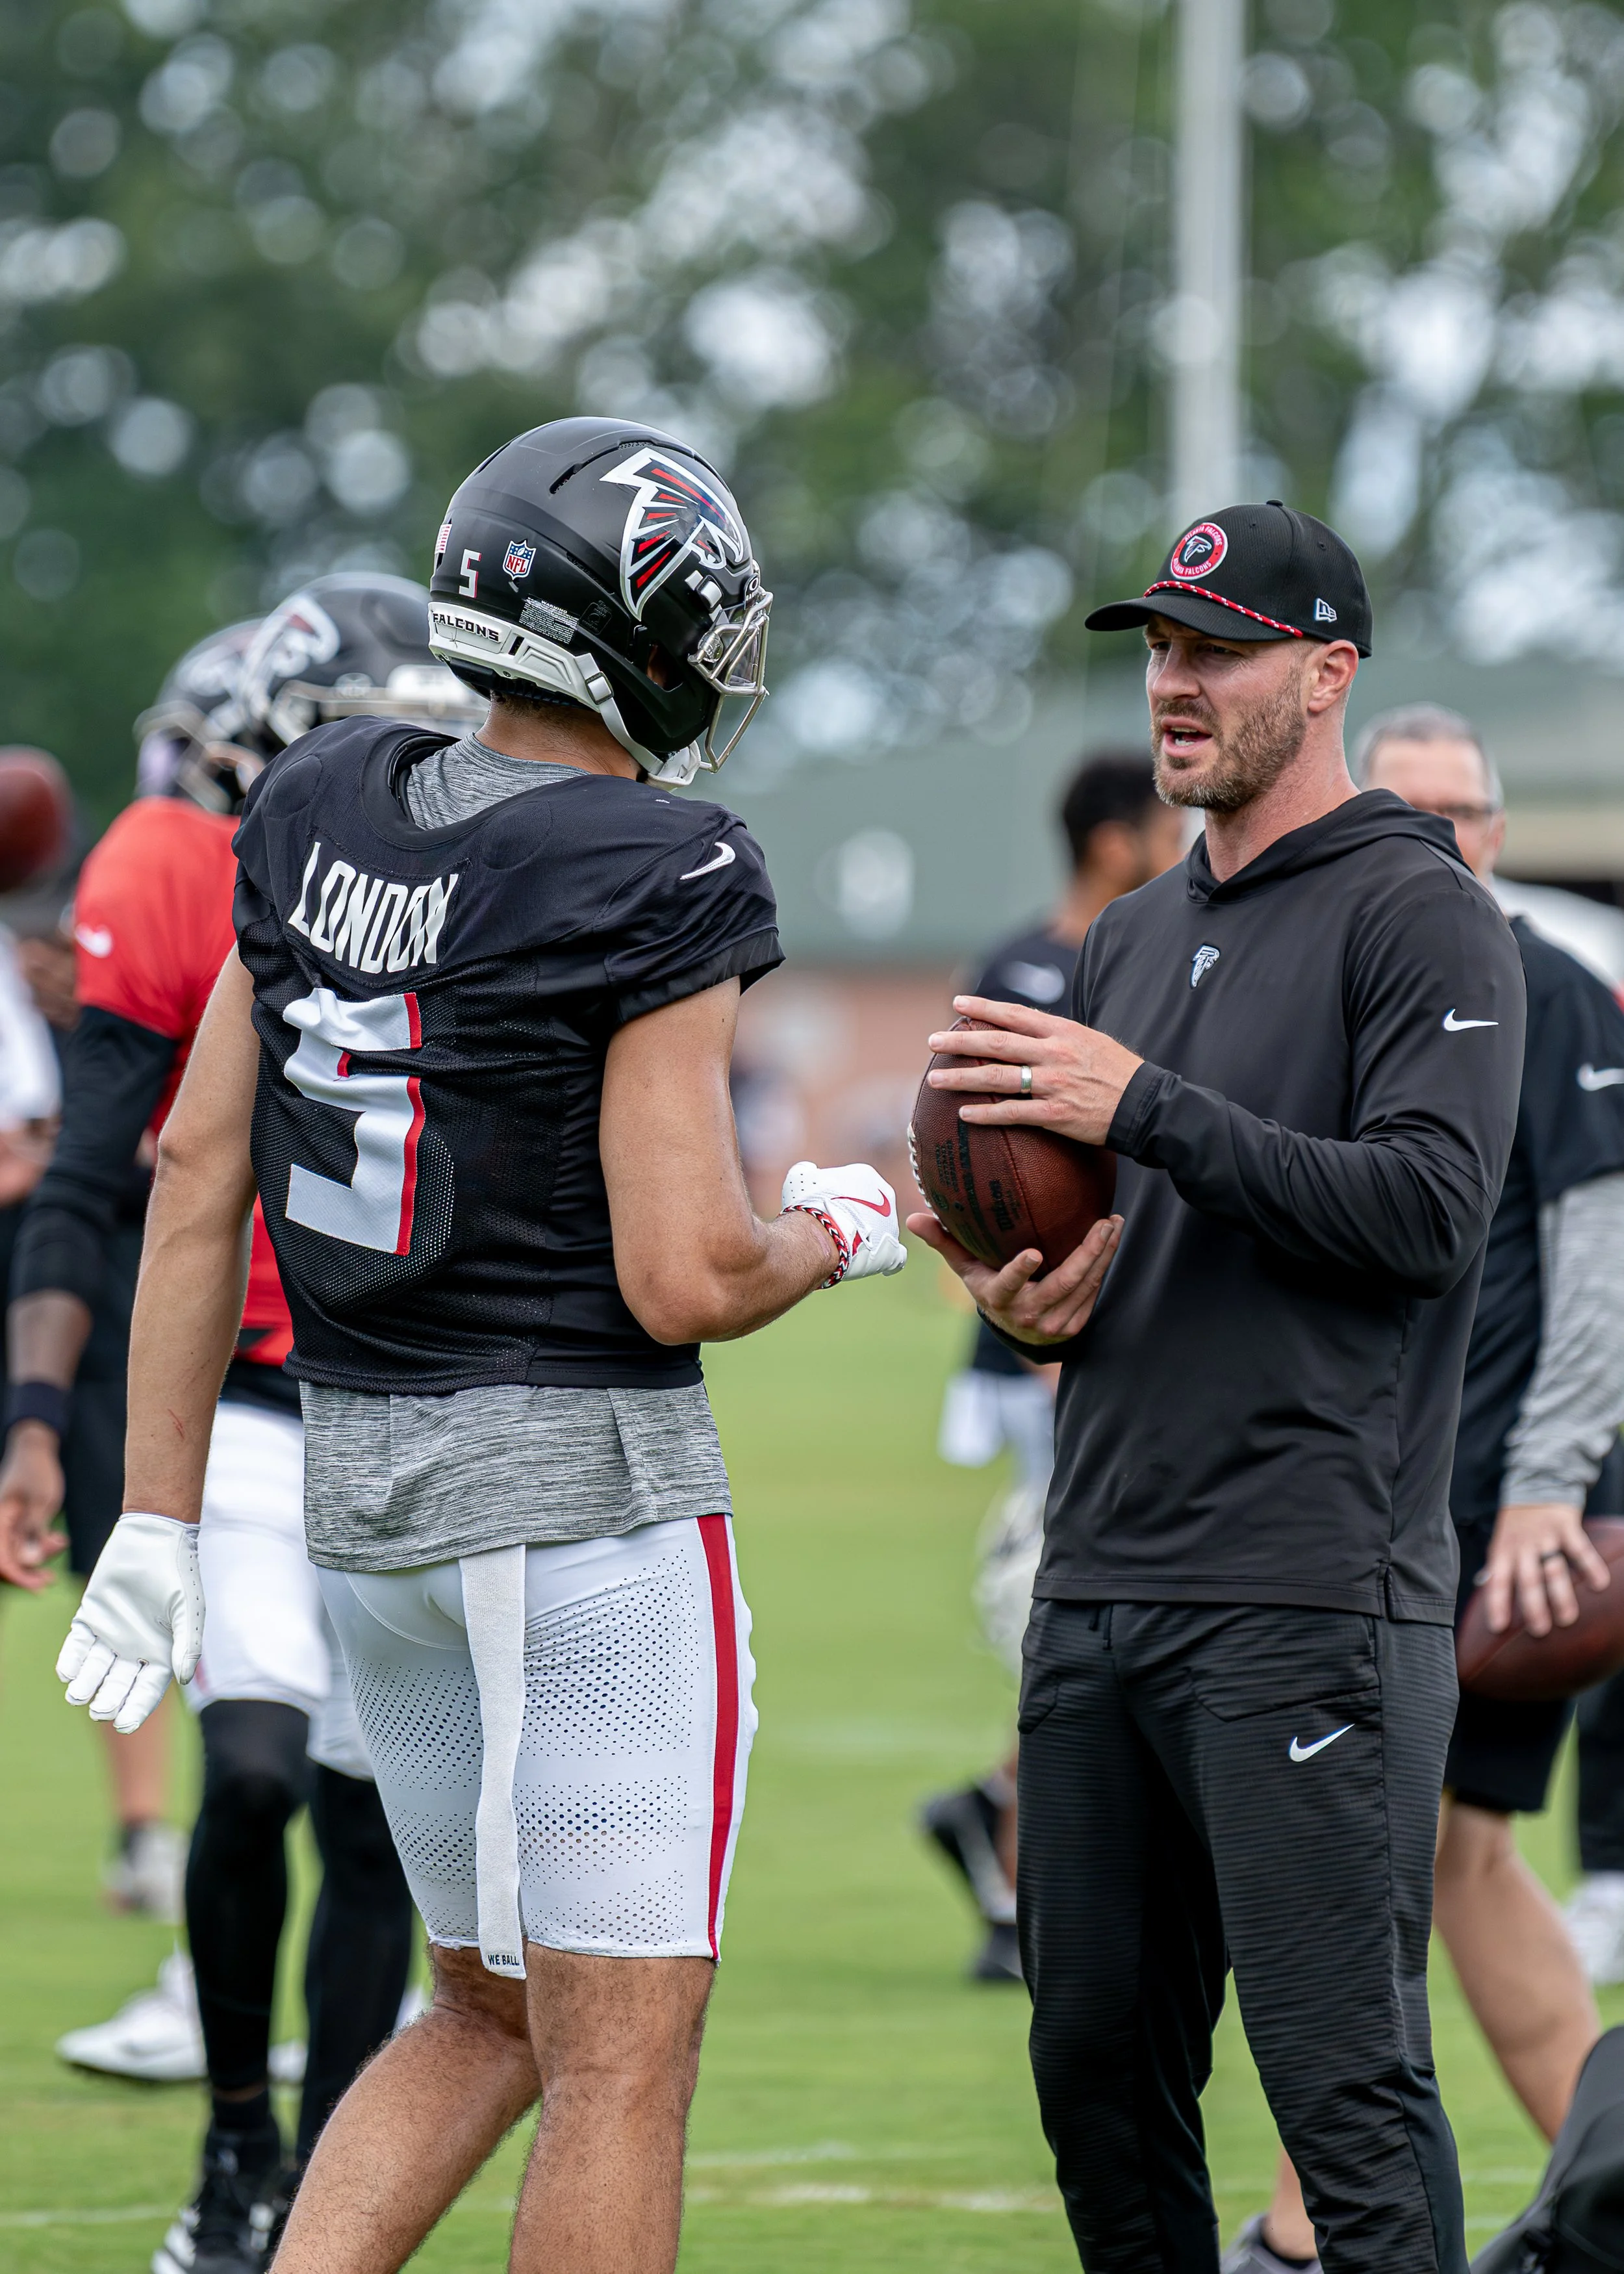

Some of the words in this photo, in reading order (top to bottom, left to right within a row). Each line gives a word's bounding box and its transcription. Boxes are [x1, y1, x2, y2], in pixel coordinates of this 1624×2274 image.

[1205, 525, 1223, 546] FALCONS
[459, 548, 482, 598] 5
[506, 555, 526, 573] NFL
[1185, 561, 1212, 576] FALCONS
[541, 600, 568, 614] WARNING
[433, 613, 500, 643] FALCONS
[288, 842, 459, 974] LONDON
[283, 988, 426, 1256] 5
[488, 1954, 500, 1965] WE
